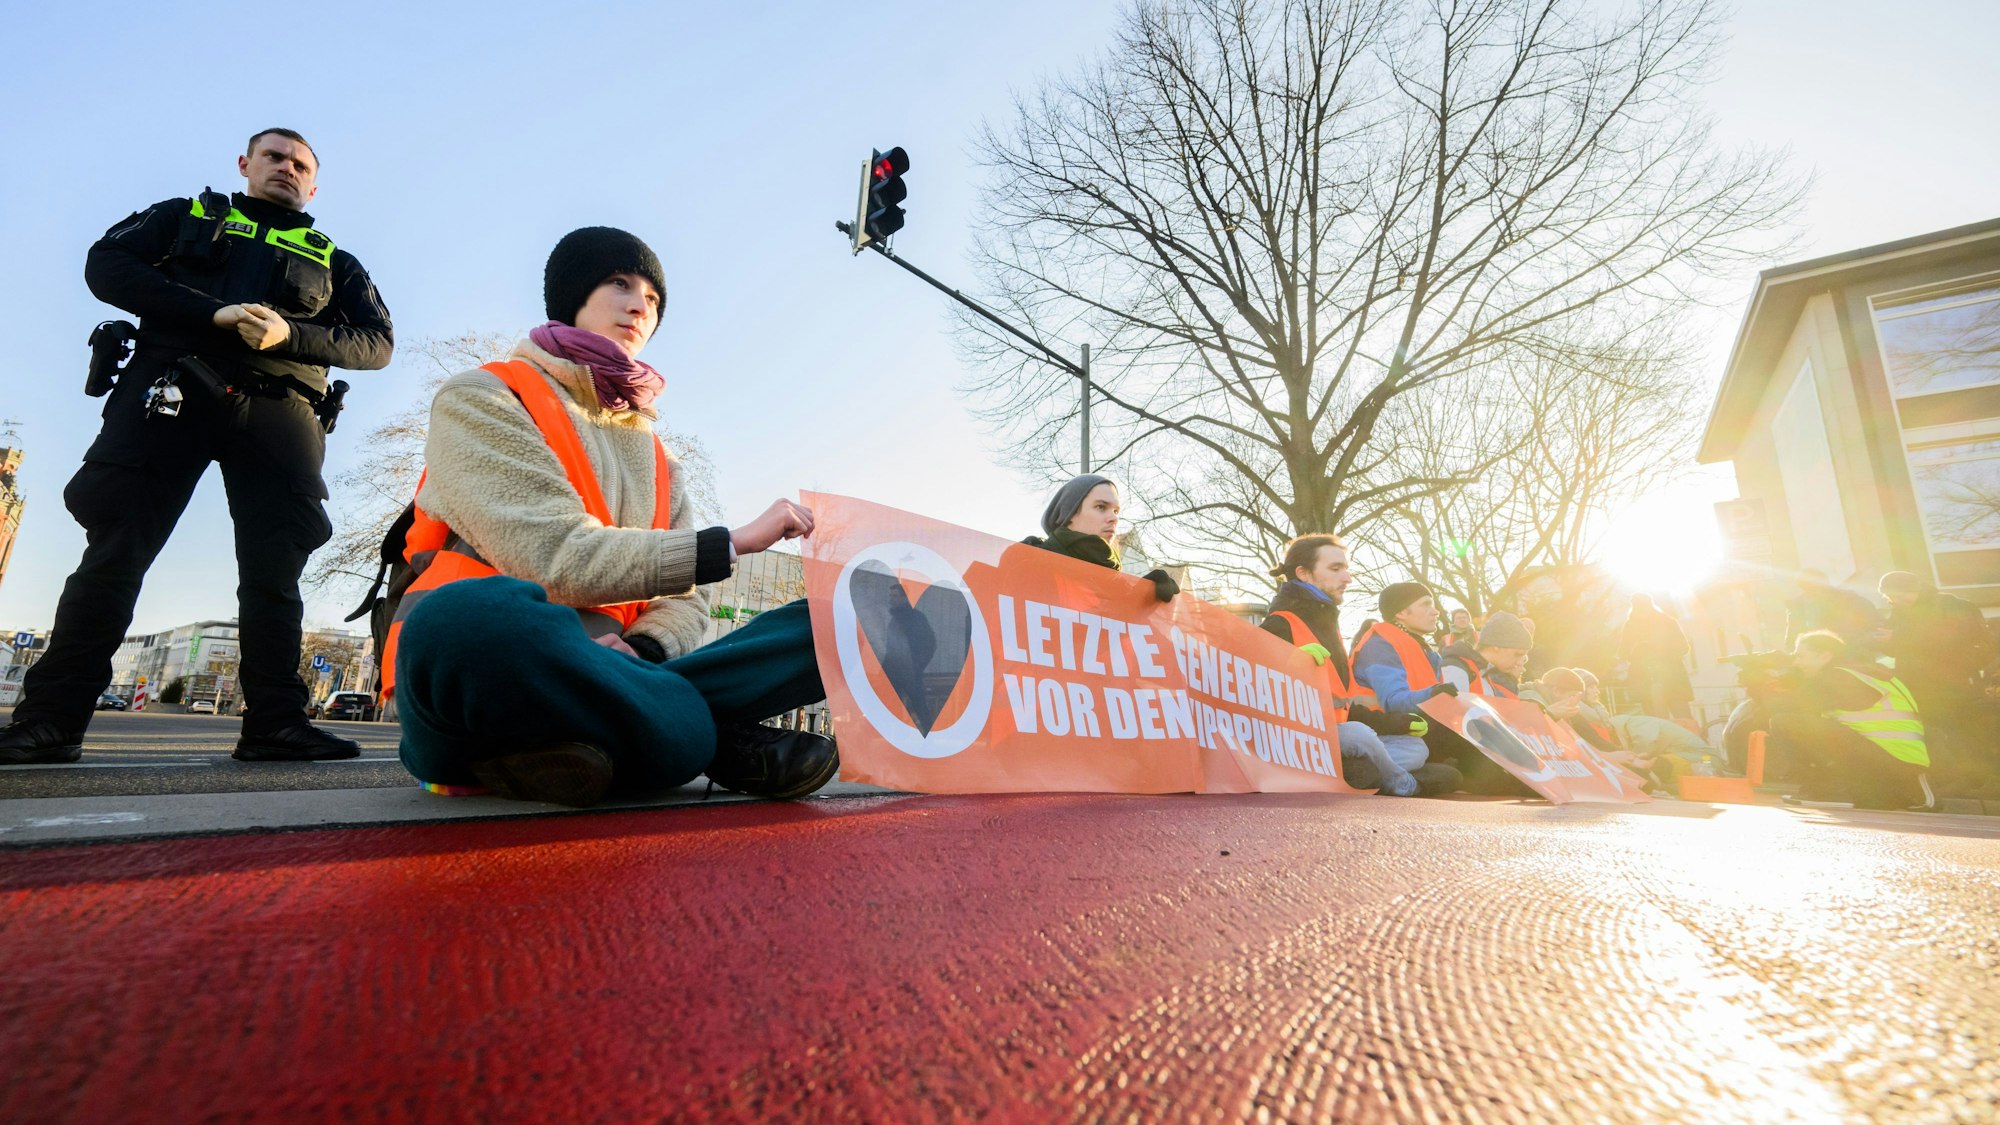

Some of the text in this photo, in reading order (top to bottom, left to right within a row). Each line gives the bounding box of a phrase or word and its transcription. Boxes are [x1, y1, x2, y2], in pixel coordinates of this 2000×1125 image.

[225, 221, 252, 234] ZEI
[17, 634, 31, 645] U
[314, 657, 324, 667] U
[998, 594, 1325, 732] LETZTE GENERATION
[1003, 673, 1101, 737] VOR
[1103, 687, 1196, 740] DEN
